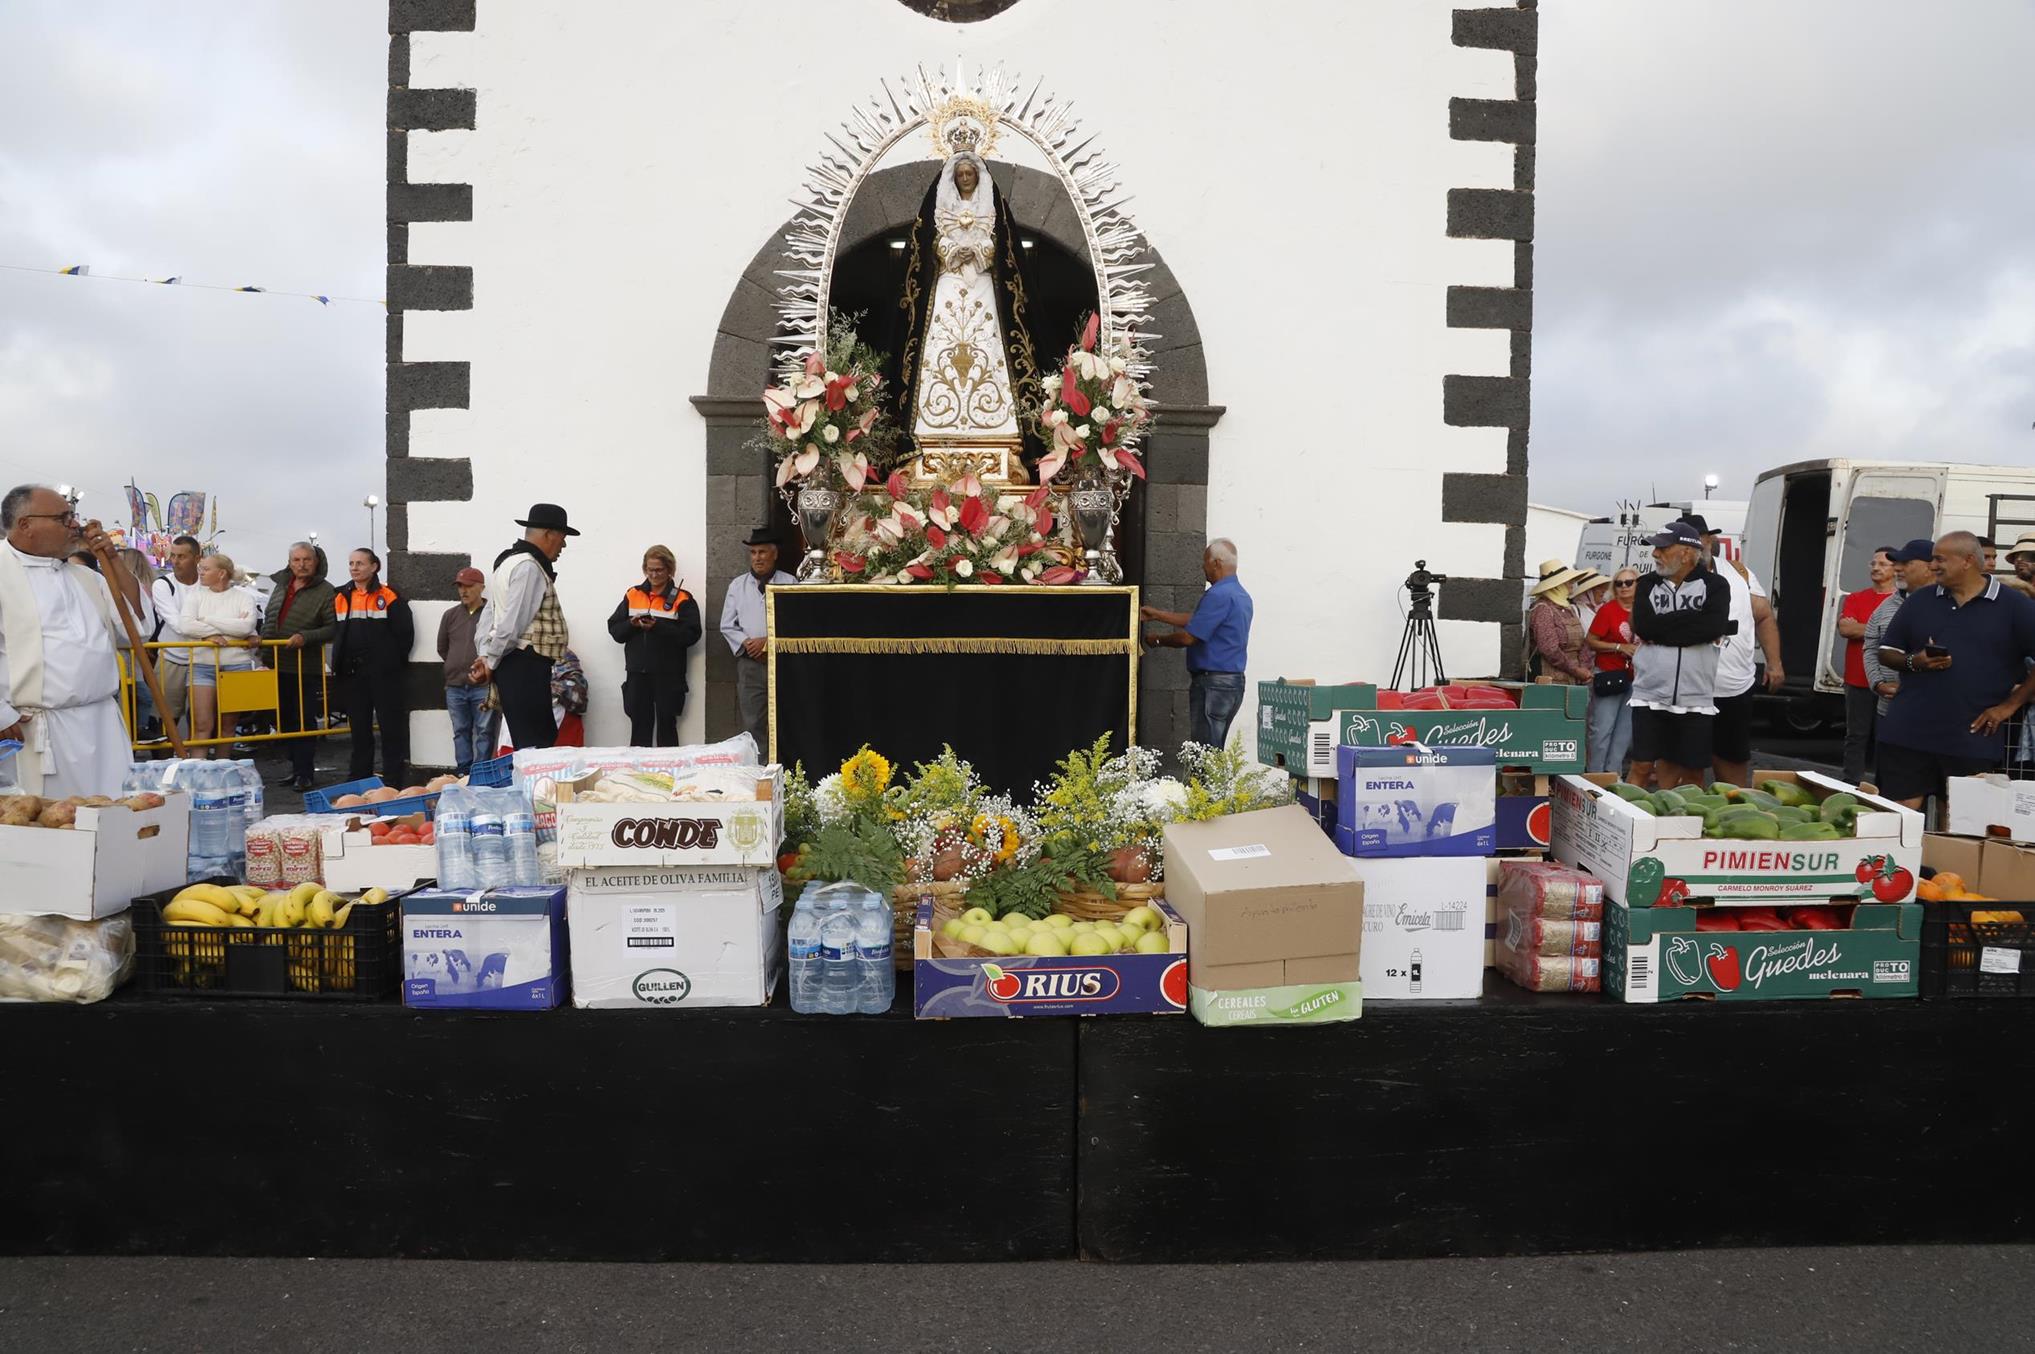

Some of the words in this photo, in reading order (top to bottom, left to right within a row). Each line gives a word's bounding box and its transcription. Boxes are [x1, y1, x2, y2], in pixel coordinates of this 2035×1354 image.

[1558, 742, 1575, 751] TO
[1416, 754, 1448, 764] unide
[1496, 749, 1539, 758] lenara
[1366, 781, 1415, 790] ENTERA
[612, 817, 723, 850] CONDE
[1703, 851, 1840, 871] PIMIENSUR
[585, 877, 599, 887] EL
[601, 875, 641, 887] ACEITE
[643, 874, 659, 885] DE
[660, 873, 696, 885] OLIVA
[698, 872, 747, 884] FAMILIA
[463, 901, 497, 912] unide
[1395, 902, 1432, 927] Emicela
[1362, 920, 1384, 933] CURO
[413, 929, 463, 938] ENTERA
[1768, 941, 1806, 957] Selección
[1745, 937, 1842, 989] Guedes
[1890, 962, 1908, 972] TO
[1386, 969, 1397, 977] 12
[1809, 970, 1869, 980] melenara
[638, 981, 685, 992] GUILLEN
[1024, 973, 1101, 997] RIUS
[1218, 996, 1267, 1010] CEREALES
[1300, 990, 1340, 1014] GLUTEN
